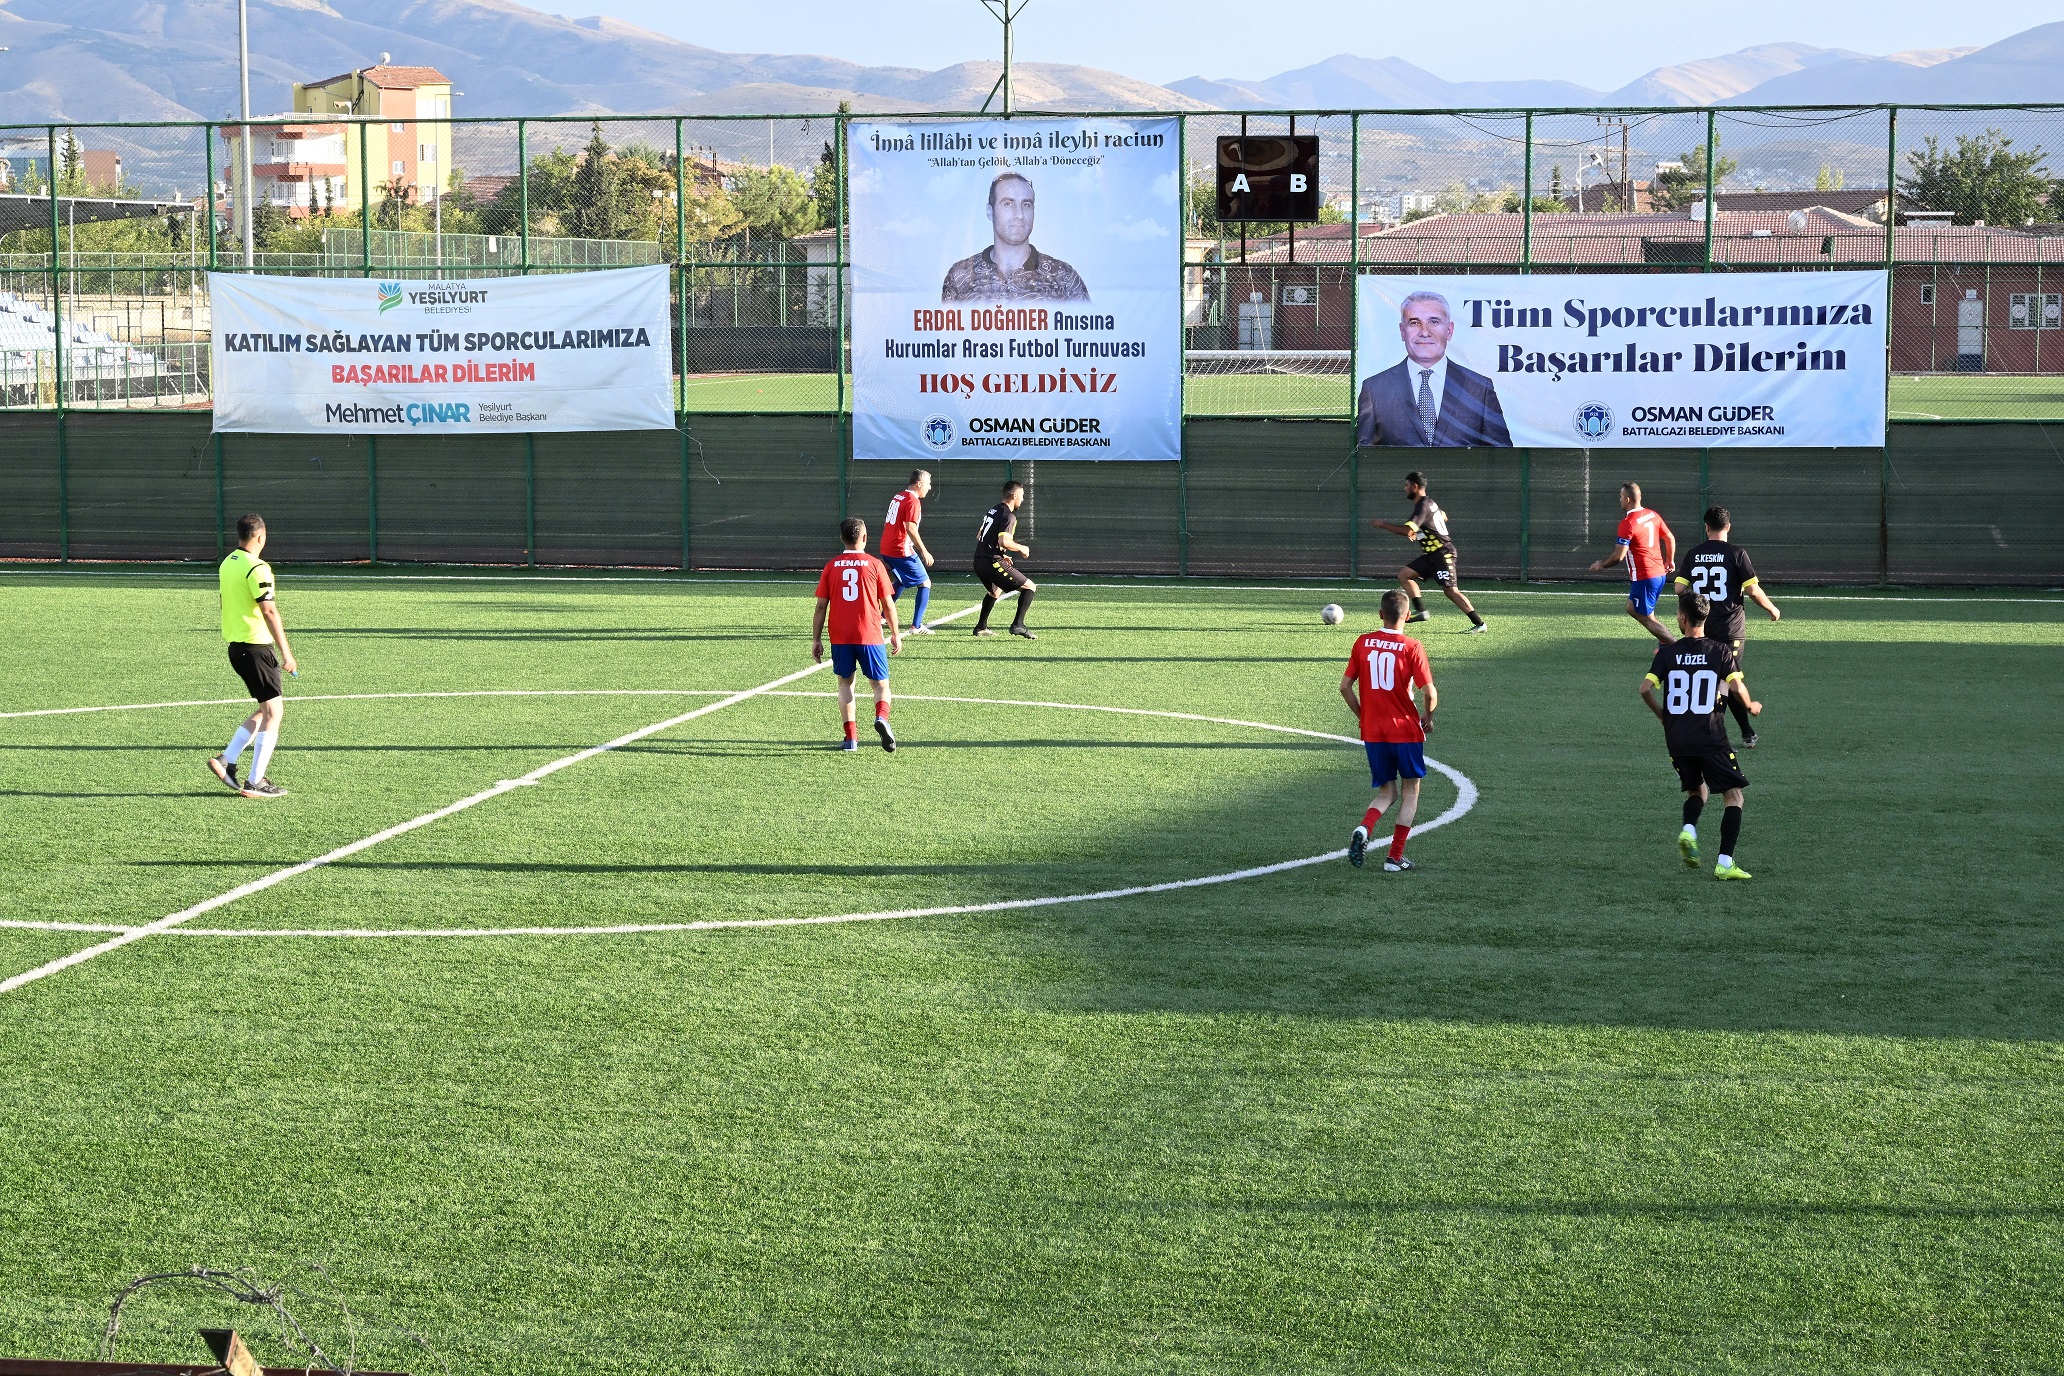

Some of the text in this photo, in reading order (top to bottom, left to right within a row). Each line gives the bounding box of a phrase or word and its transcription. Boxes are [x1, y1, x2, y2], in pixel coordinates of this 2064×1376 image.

[870, 129, 1164, 153] İnnâ lillâhi ve innâ ileyhi raciun
[1231, 173, 1308, 193] A B
[428, 283, 467, 291] MALATYA
[408, 290, 488, 305] YEŞİLYURT
[424, 306, 472, 314] BELEDİYESİ
[913, 305, 1115, 331] ERDAL DOĞANER Anısına
[1463, 296, 1873, 338] Tüm Sporcularımıza
[225, 327, 651, 353] KATILIM SAĞLAYAN TÜM SPORCULARIMIZA
[885, 338, 1146, 358] Kurumlar Arası Futbol Turnuvası
[1496, 341, 1847, 382] Başarılar Dilerim
[331, 358, 535, 387] BAŞARILAR DİLERİM
[919, 367, 1118, 400] HOŞ GELDİNİZ
[325, 402, 472, 427] Mehmet ÇINAR
[478, 402, 513, 412] Yeşilyurt
[479, 412, 547, 422] Belediye Başkanı
[1631, 405, 1775, 422] OSMAN GÜDER
[969, 417, 1035, 434] OSMAN
[1039, 417, 1101, 434] GÜDER
[1622, 427, 1687, 436] BATTALGAZİ
[1688, 426, 1736, 436] BELEDİYE
[961, 437, 1111, 448] BATTALGAZİ BELEDİYE BAŞKANI
[834, 560, 869, 568] KENAN
[1694, 552, 1724, 563] S.KESKİN
[842, 568, 859, 602] 3
[1691, 566, 1728, 602] 23
[1364, 638, 1407, 652] LEVENT
[1675, 653, 1708, 666] V.ÖZEL
[1367, 649, 1396, 692] 10
[1666, 669, 1718, 715] 80
